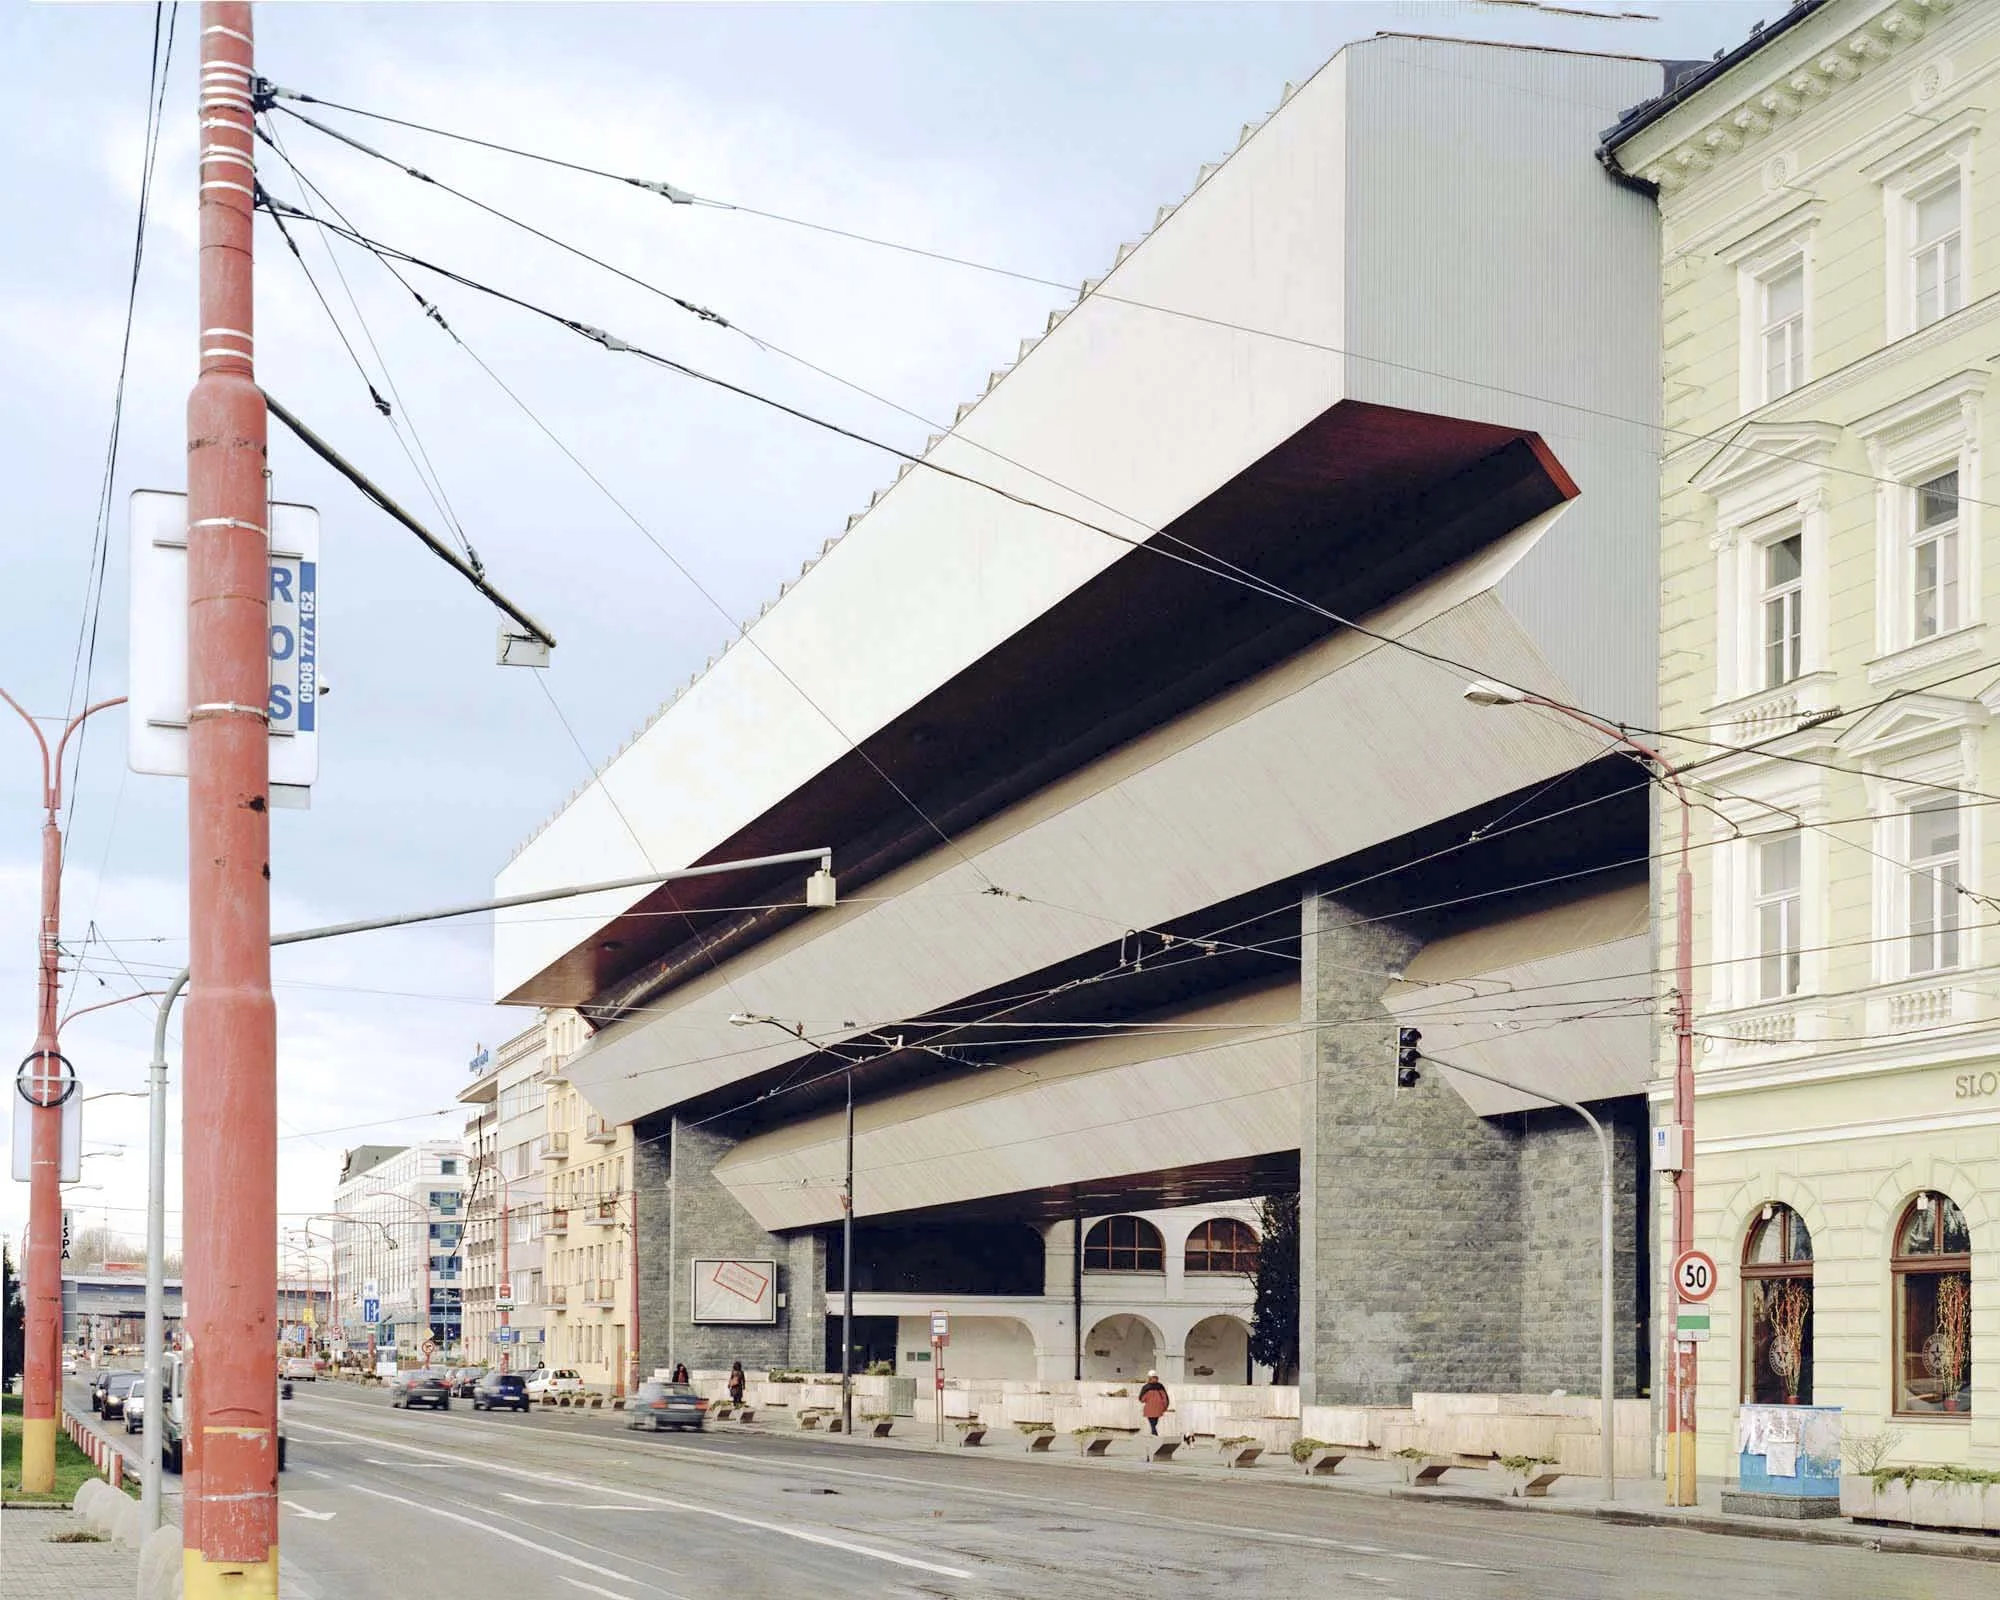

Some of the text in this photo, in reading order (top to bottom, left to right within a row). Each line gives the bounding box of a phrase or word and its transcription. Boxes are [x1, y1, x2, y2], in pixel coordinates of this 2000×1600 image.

[299, 591, 315, 704] 0908 777 152
[1955, 1071, 2000, 1099] SLO
[61, 1216, 71, 1260] ISPA
[1685, 1264, 1707, 1288] 50
